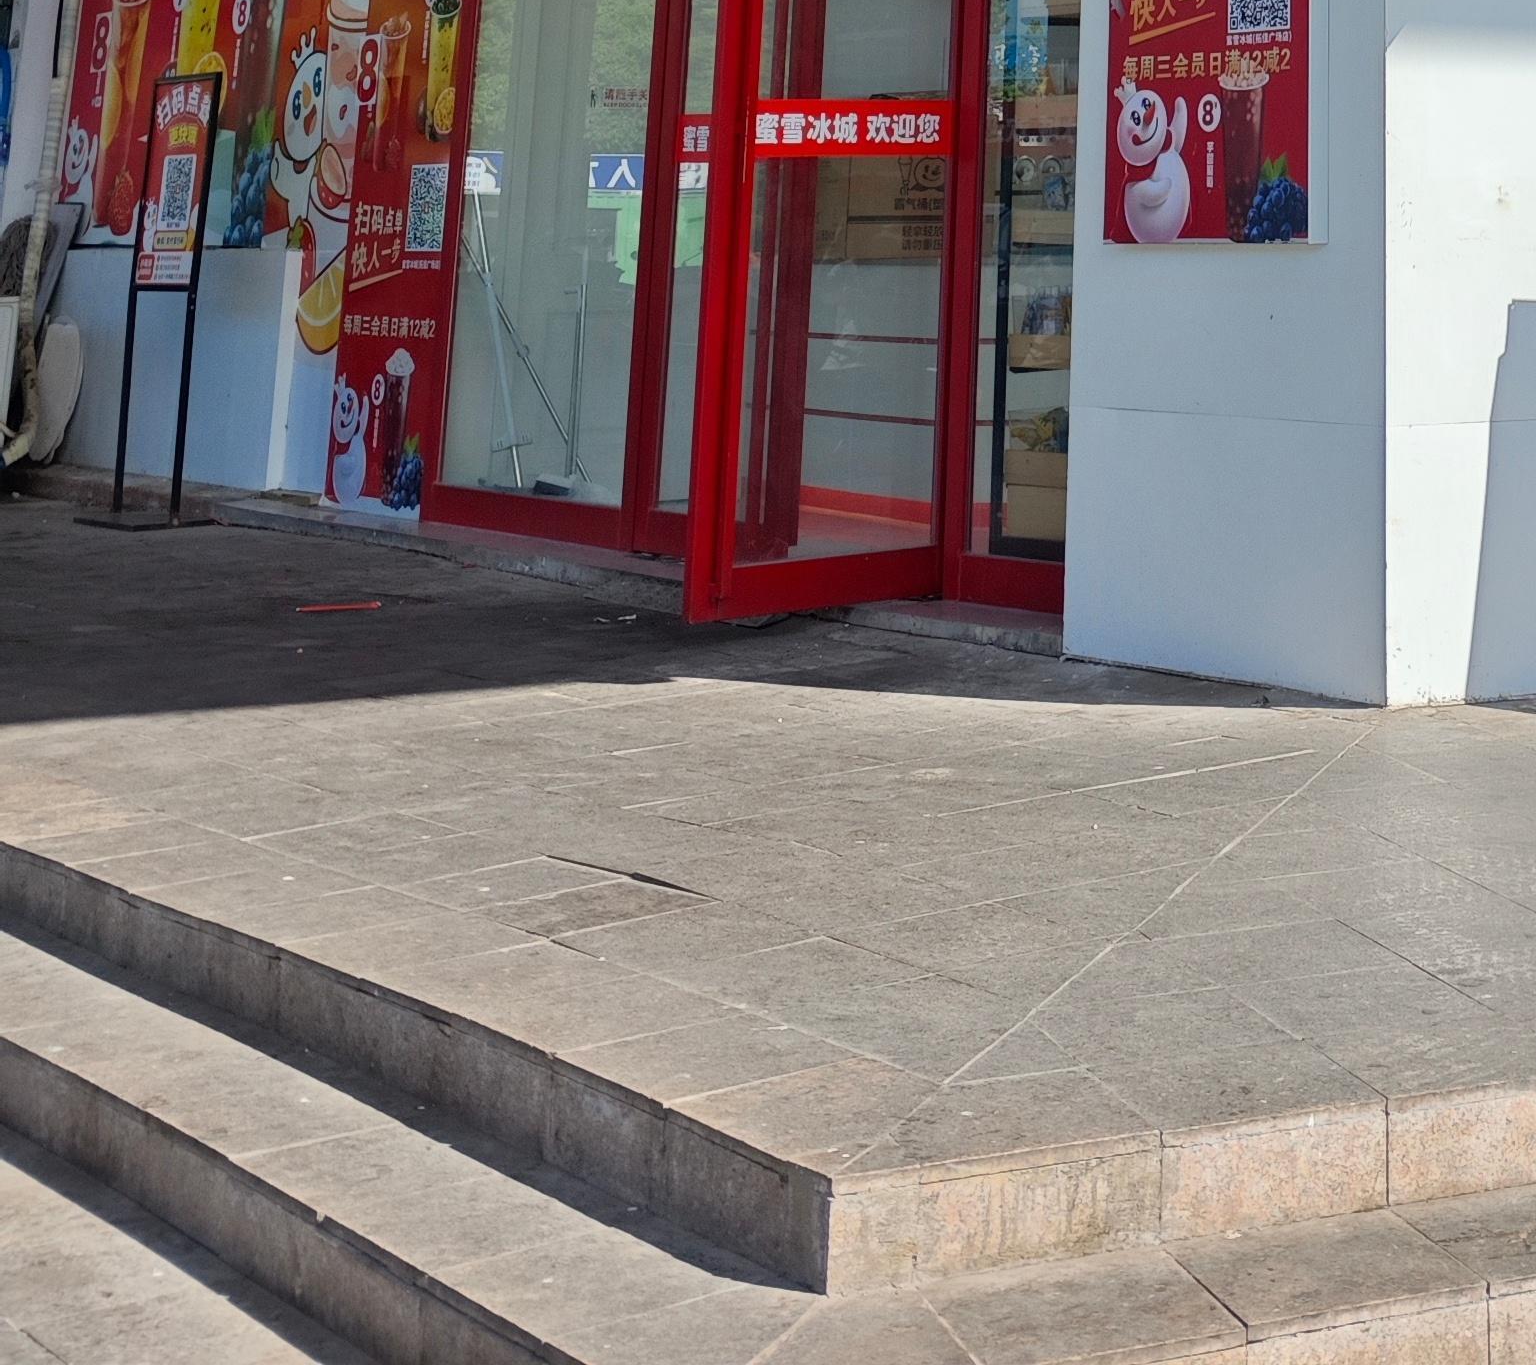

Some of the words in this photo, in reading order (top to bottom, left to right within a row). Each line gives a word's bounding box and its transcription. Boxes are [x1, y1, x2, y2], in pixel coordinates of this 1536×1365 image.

[92, 15, 111, 71] 8
[356, 38, 380, 104] 8
[755, 112, 858, 145] 蜜雪冰城
[866, 112, 941, 144] 欢迎您
[354, 200, 404, 237] 扫码点单
[351, 237, 401, 280] 快人一步
